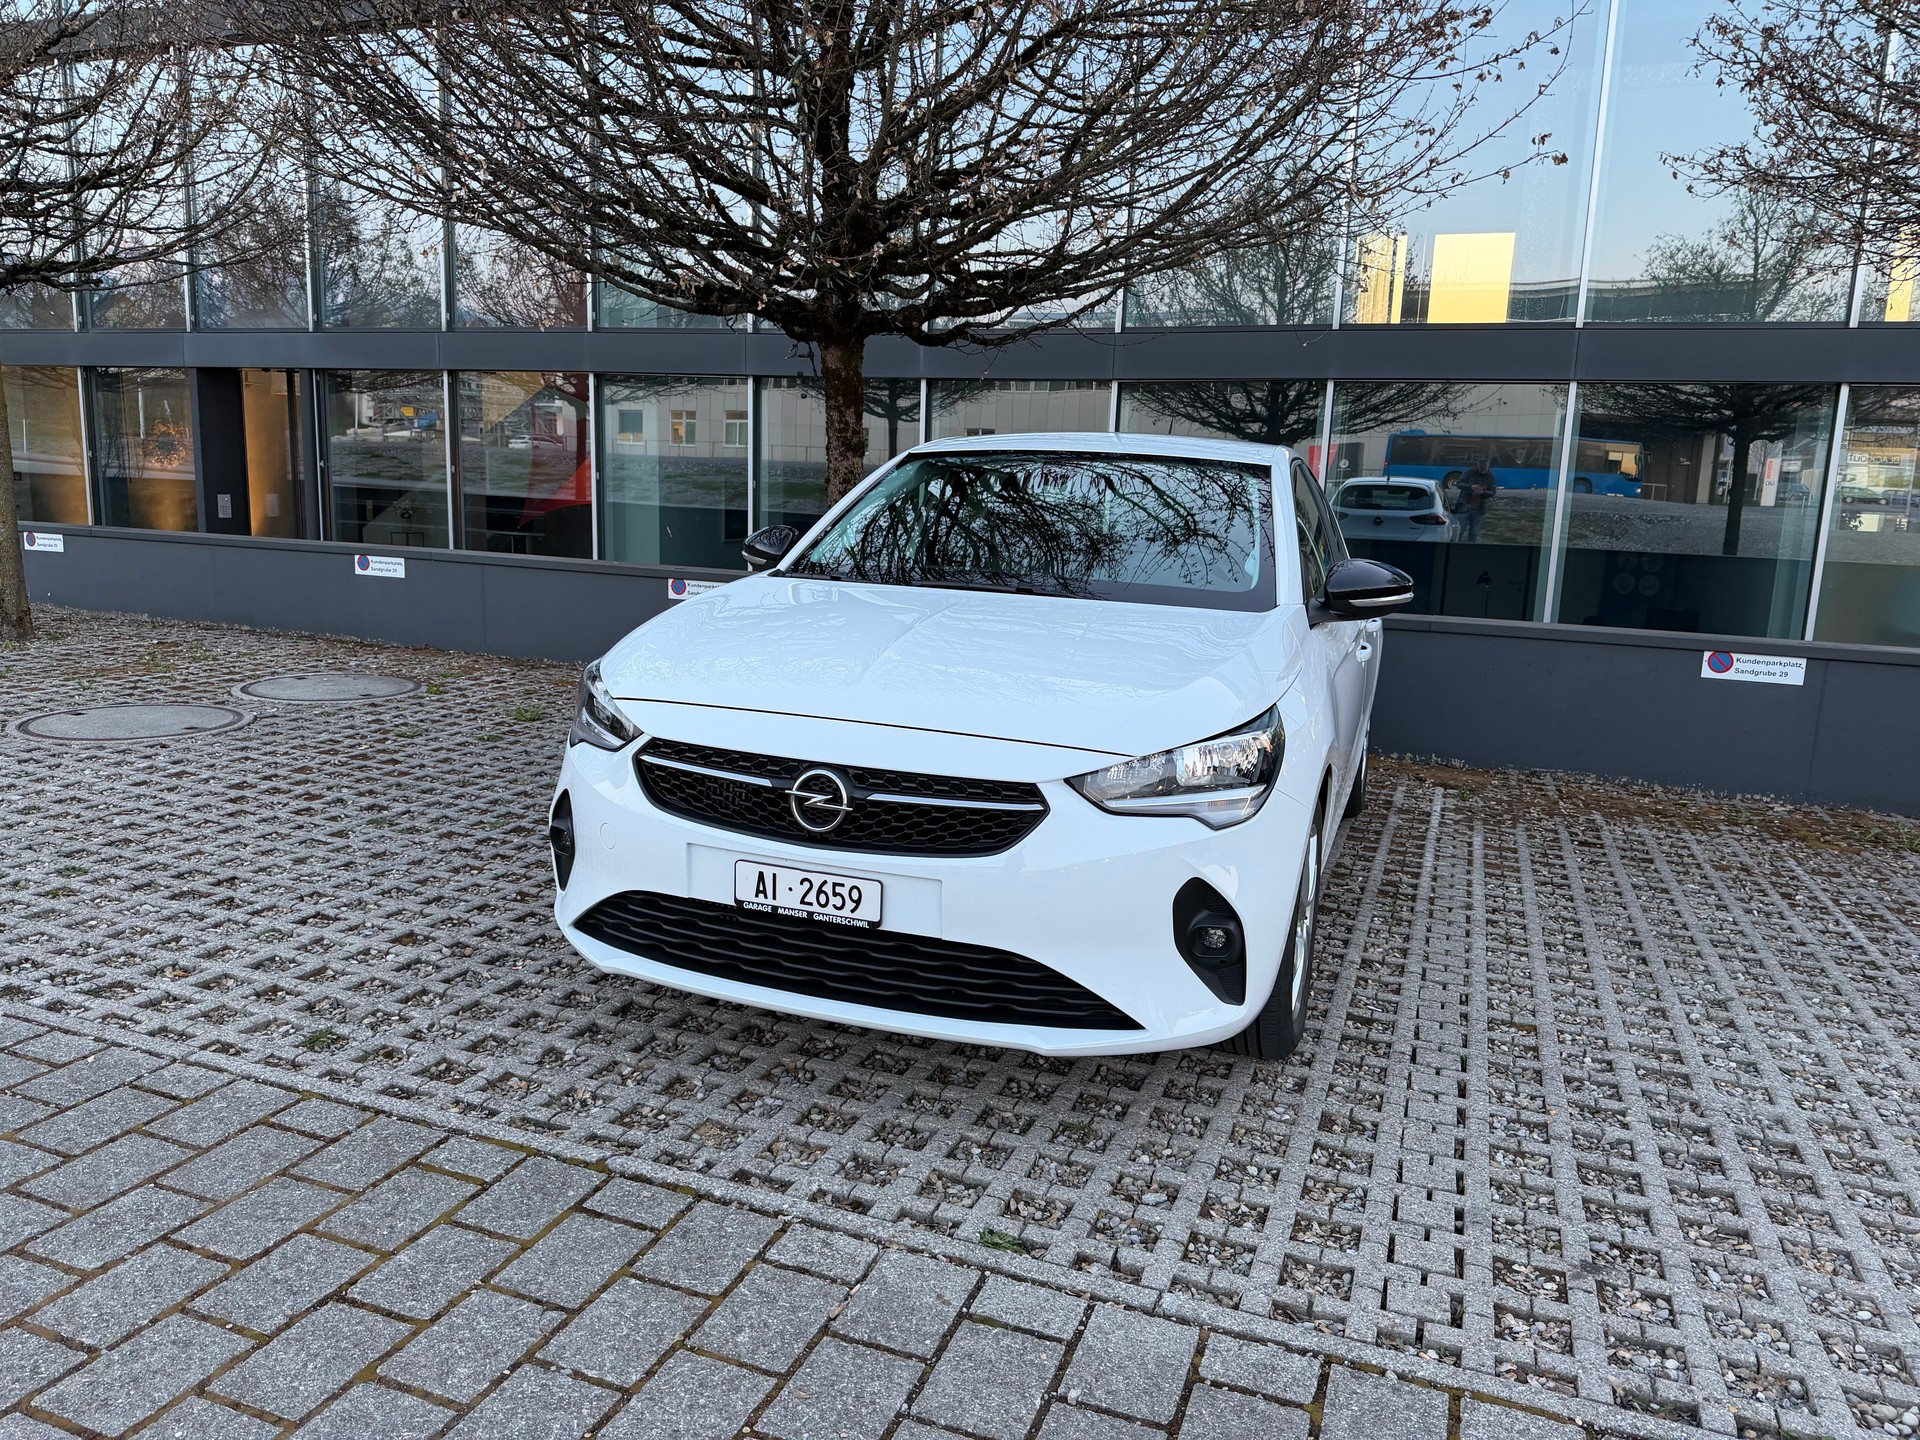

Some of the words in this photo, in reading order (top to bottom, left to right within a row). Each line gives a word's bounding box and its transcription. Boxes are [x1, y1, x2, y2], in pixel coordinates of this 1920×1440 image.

[1734, 667, 1777, 677] Sandgrube
[1736, 657, 1803, 669] Kundenparkplatz
[754, 870, 777, 901] AI
[799, 877, 863, 914] 2659
[743, 901, 773, 913] GARAGE
[777, 907, 808, 919] MANSER
[813, 913, 870, 929] GANTERSCHWIL
